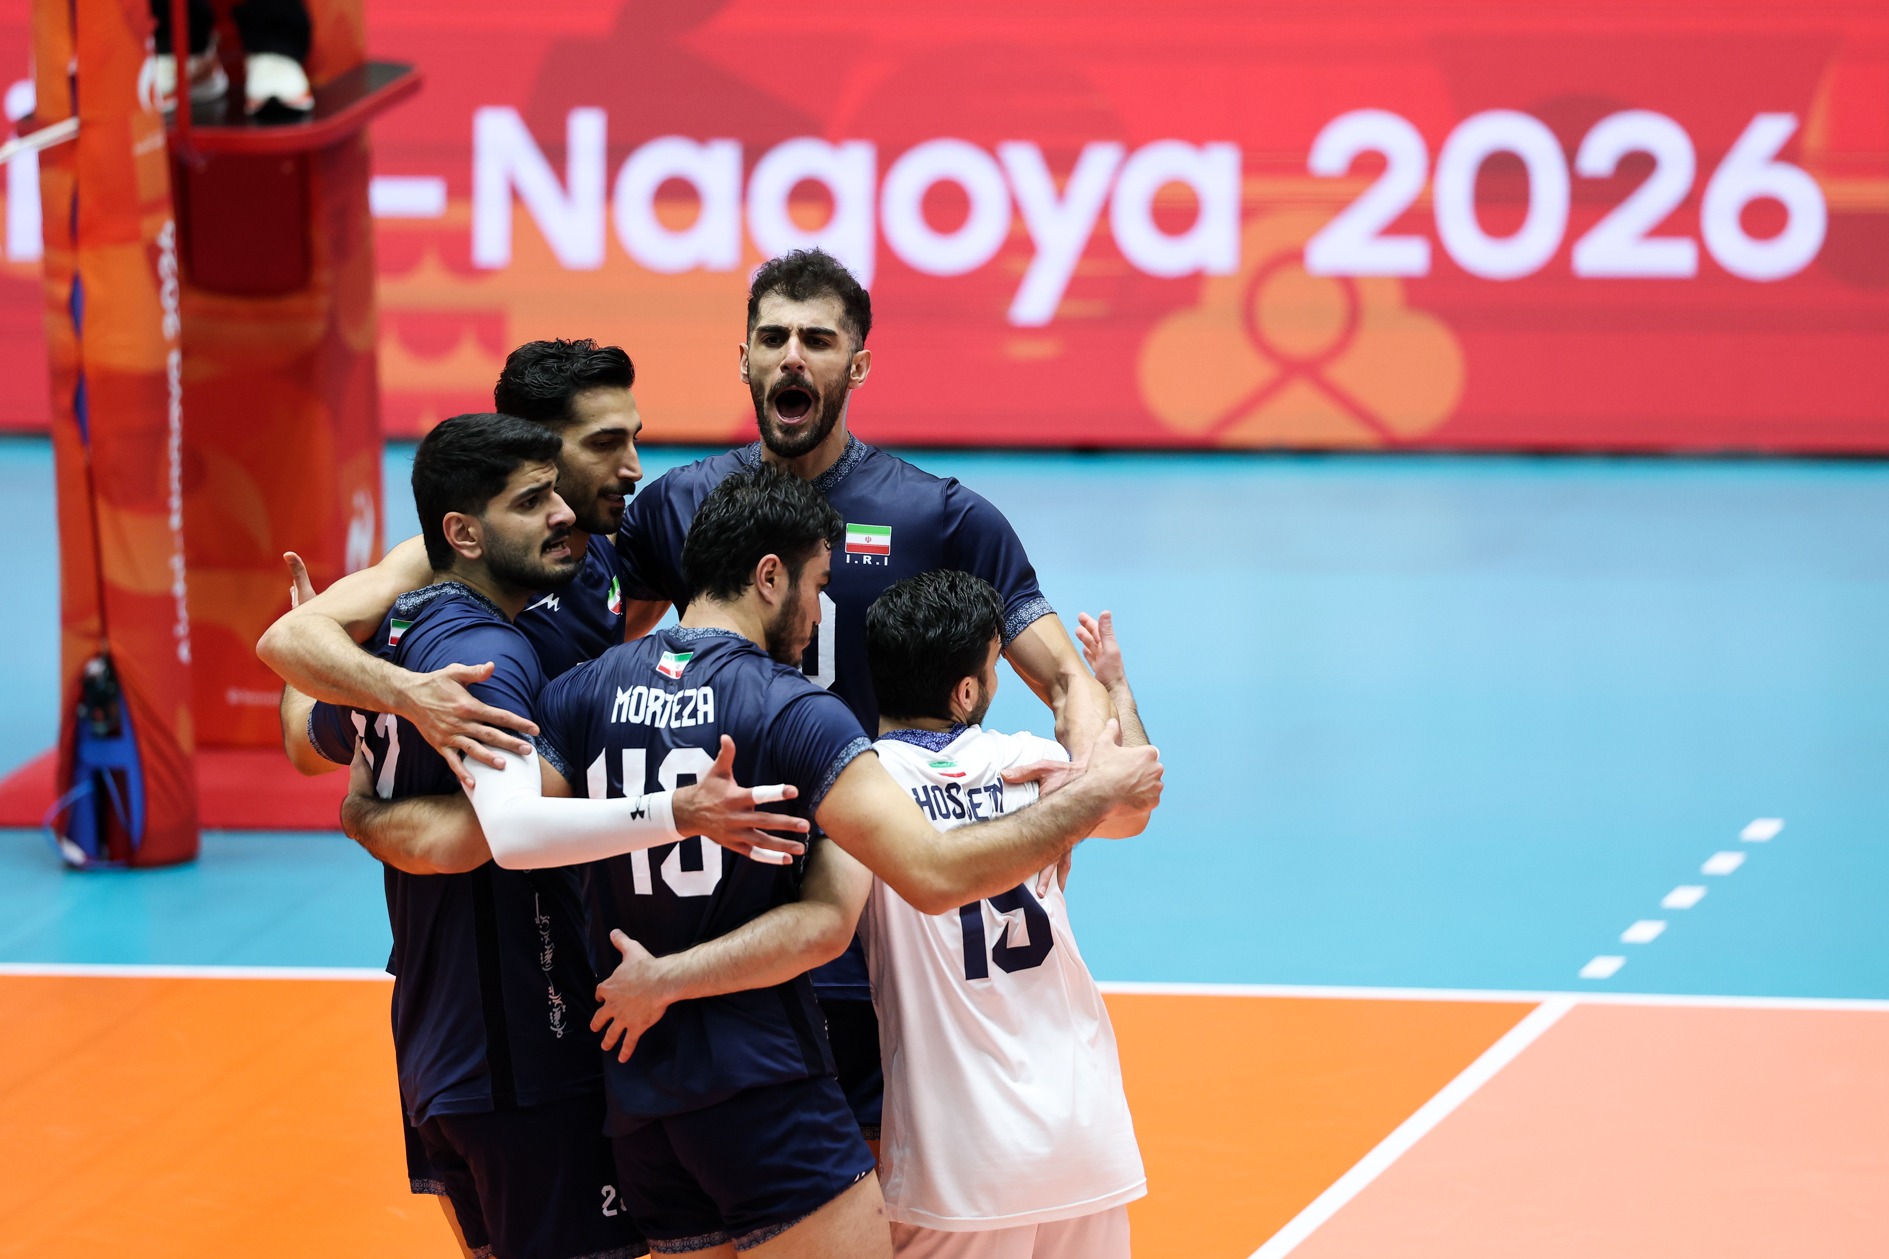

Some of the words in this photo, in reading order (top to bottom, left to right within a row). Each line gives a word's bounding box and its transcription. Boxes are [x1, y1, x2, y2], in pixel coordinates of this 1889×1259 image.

[1304, 108, 1828, 283] 2026
[846, 554, 888, 566] I.R.I
[610, 685, 715, 729] MORTEZA
[600, 1184, 628, 1217] 2
